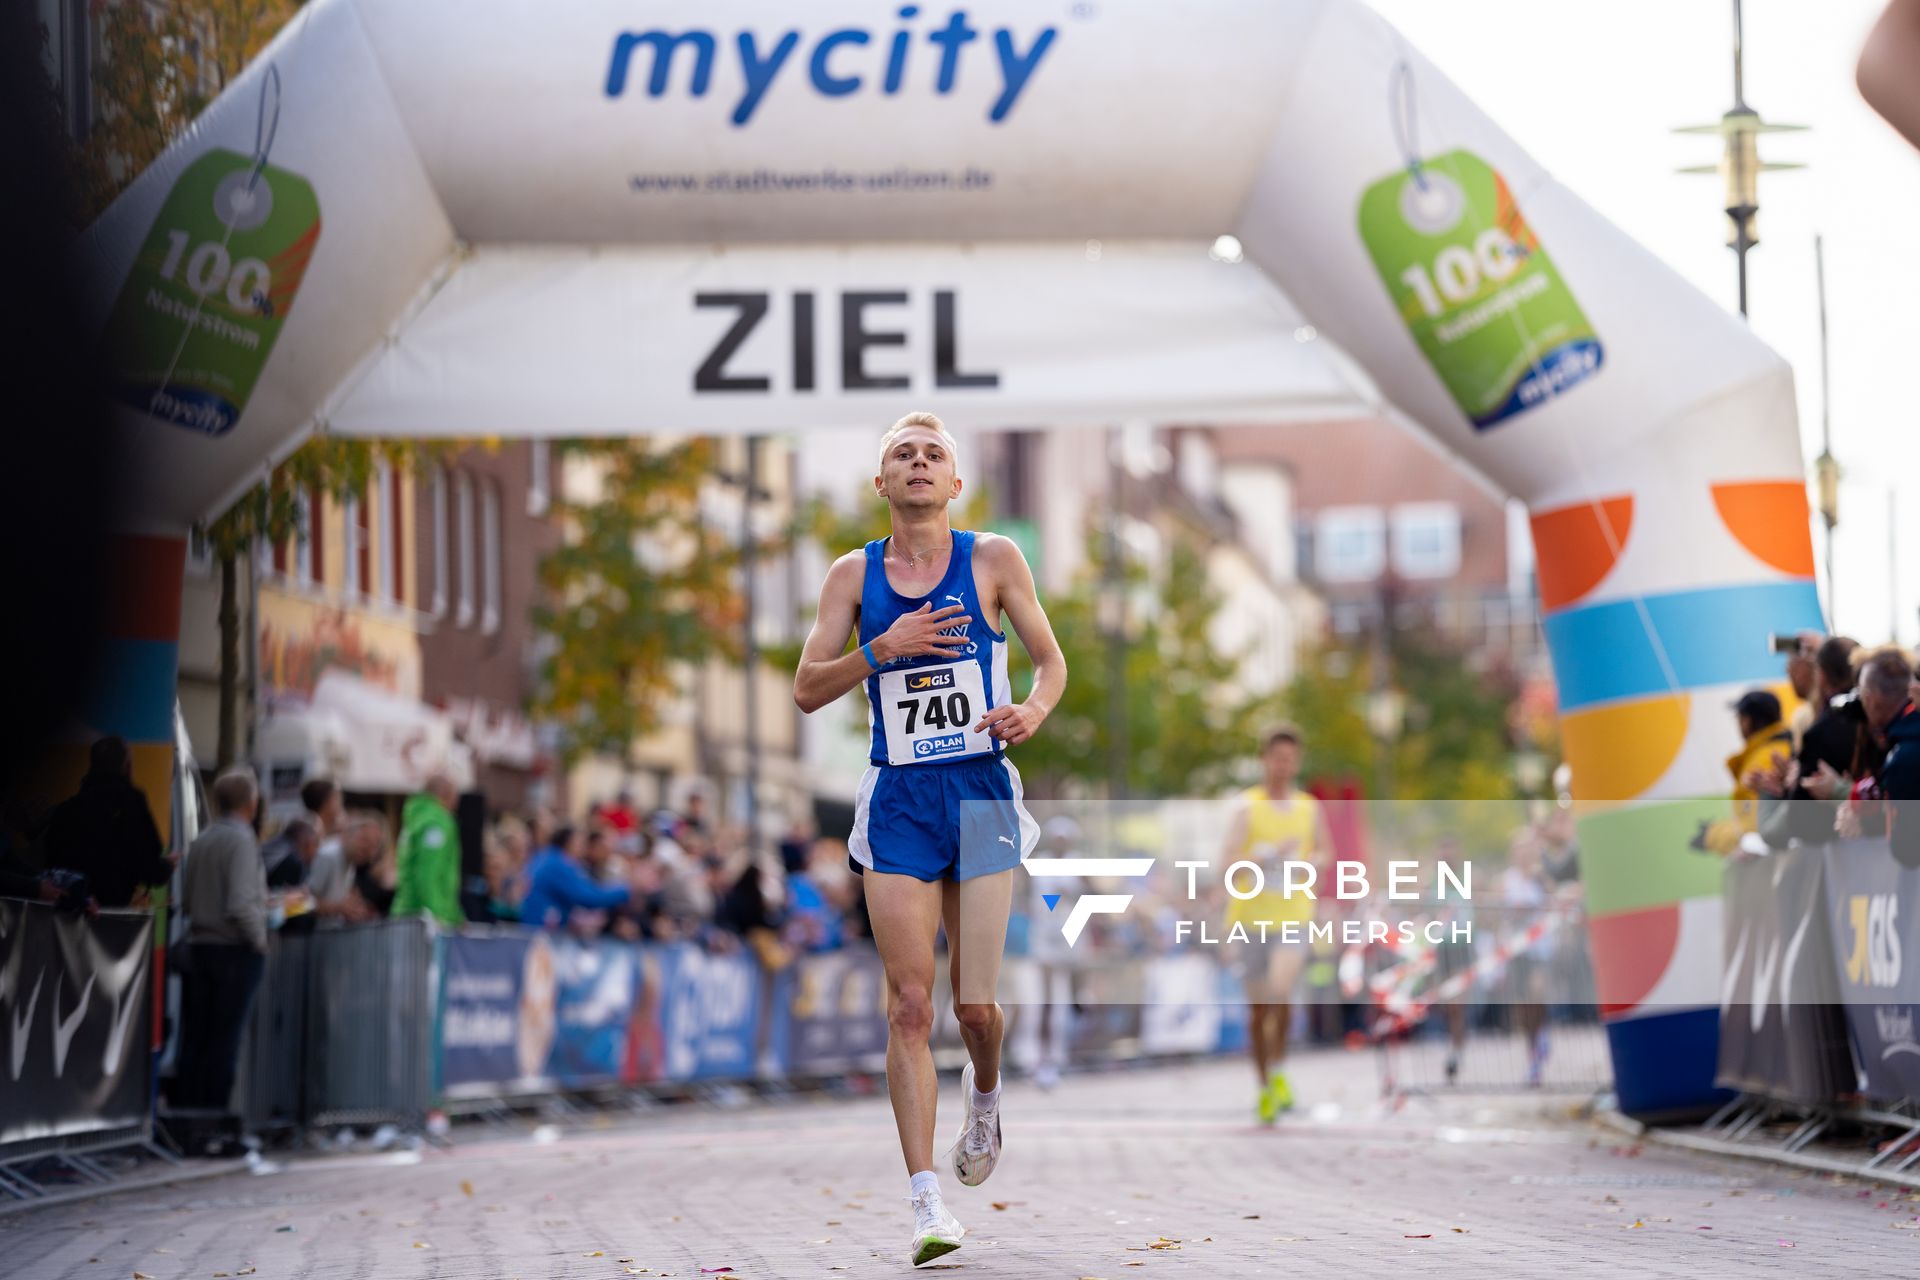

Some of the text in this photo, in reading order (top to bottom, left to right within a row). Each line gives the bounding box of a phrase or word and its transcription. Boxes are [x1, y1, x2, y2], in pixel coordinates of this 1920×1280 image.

[605, 4, 1058, 126] mycity
[693, 289, 1000, 393] ZIEL
[931, 674, 951, 686] GLS
[897, 692, 971, 735] 740
[934, 737, 963, 749] PLAN
